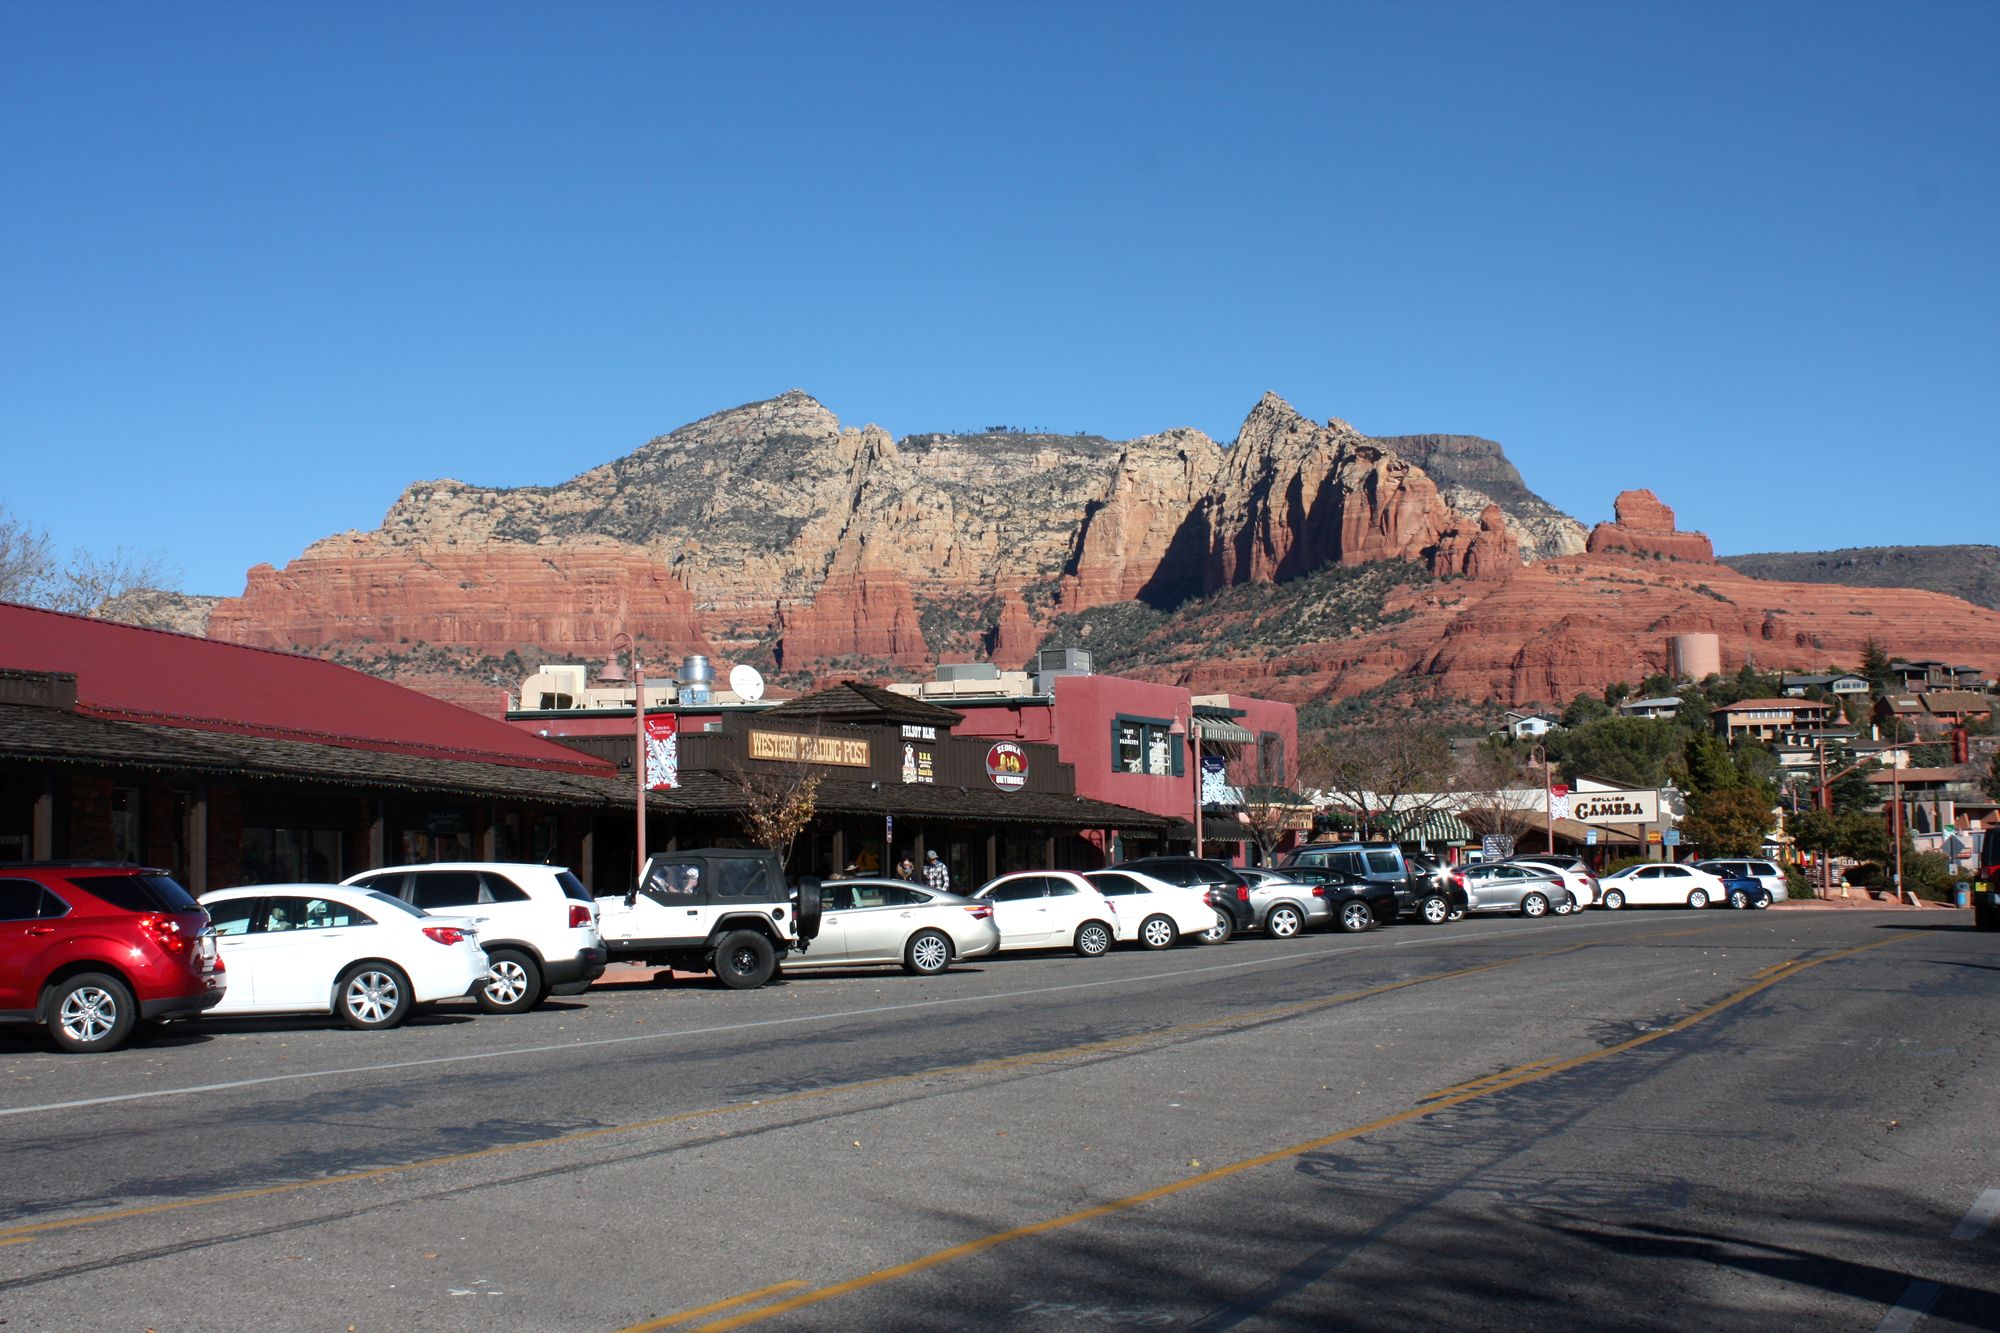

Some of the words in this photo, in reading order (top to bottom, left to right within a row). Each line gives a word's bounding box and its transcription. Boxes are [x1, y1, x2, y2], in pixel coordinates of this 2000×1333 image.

[752, 732, 797, 758] WESTERN
[800, 736, 842, 762] TRADING
[843, 740, 867, 764] POST
[996, 744, 1021, 756] SEDONA
[995, 775, 1024, 785] OUTDOORS
[1575, 802, 1643, 820] CAMERA
